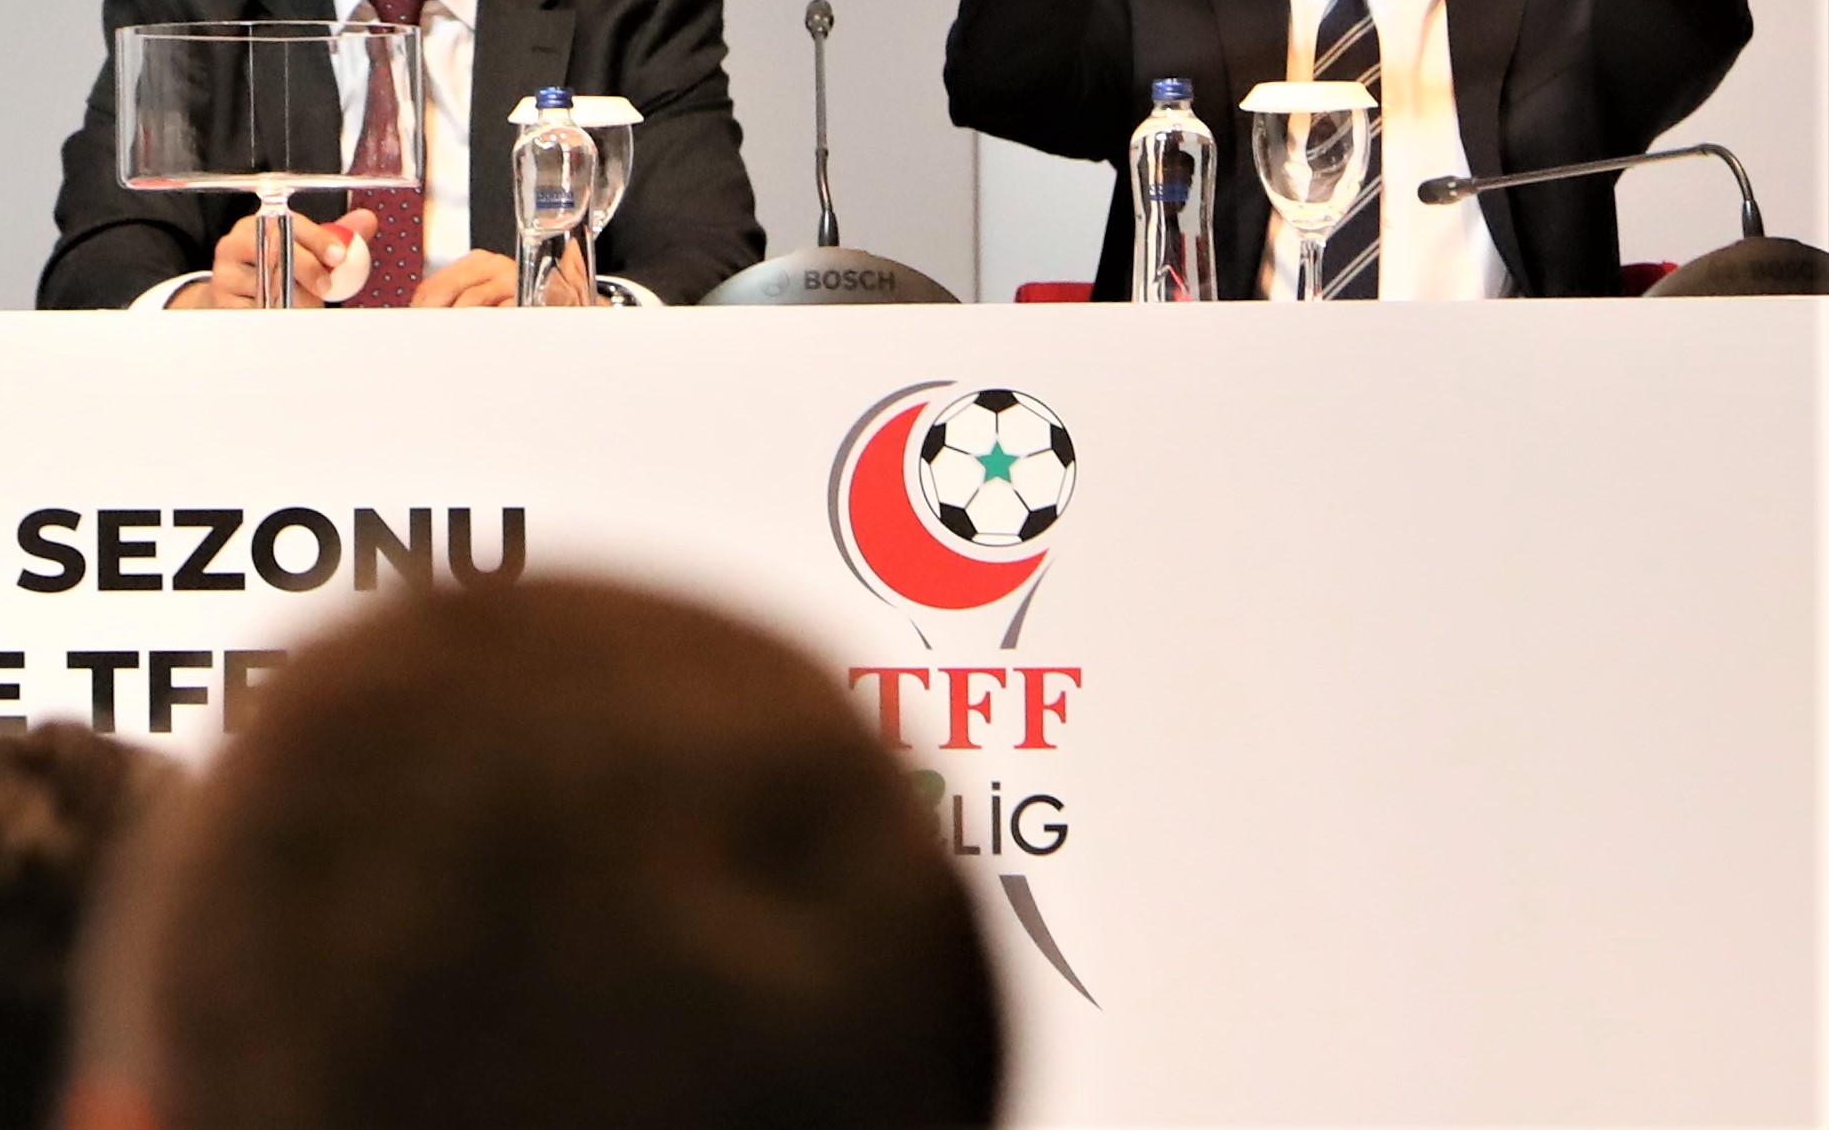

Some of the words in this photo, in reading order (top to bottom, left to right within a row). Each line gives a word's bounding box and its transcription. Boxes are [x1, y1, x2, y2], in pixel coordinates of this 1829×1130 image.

[803, 269, 896, 291] BOSCH
[16, 506, 526, 594] SEZONU
[848, 666, 1082, 750] TFF
